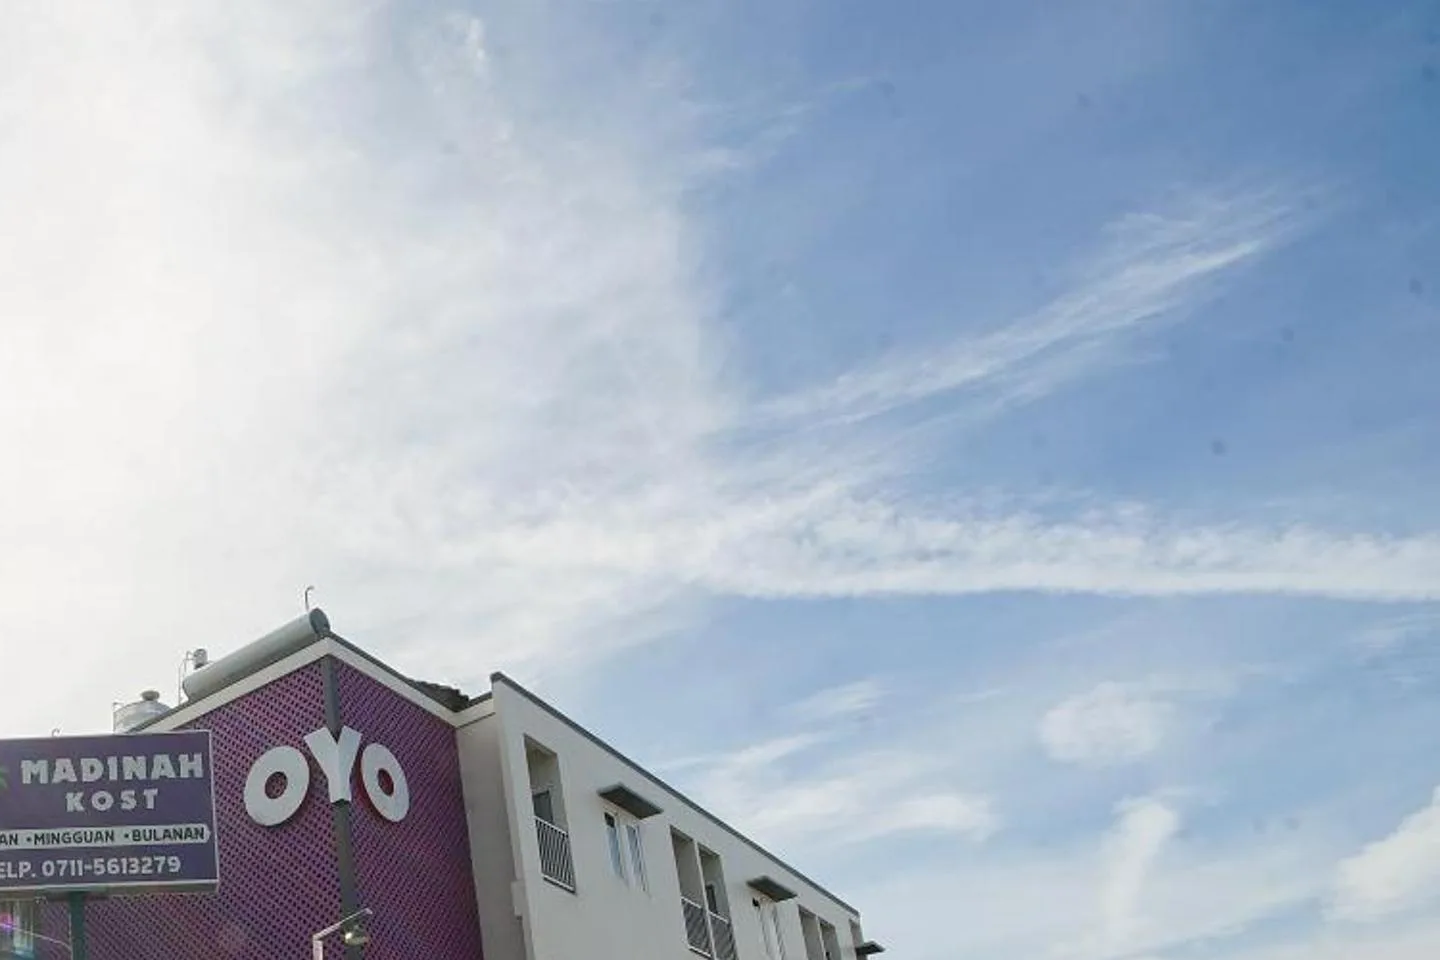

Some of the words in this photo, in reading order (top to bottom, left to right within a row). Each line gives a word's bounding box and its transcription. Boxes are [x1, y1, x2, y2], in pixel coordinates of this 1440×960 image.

[20, 752, 204, 784] MADINAH
[243, 725, 410, 826] OYO
[65, 788, 158, 812] KOST
[42, 855, 181, 877] 0711-5613279
